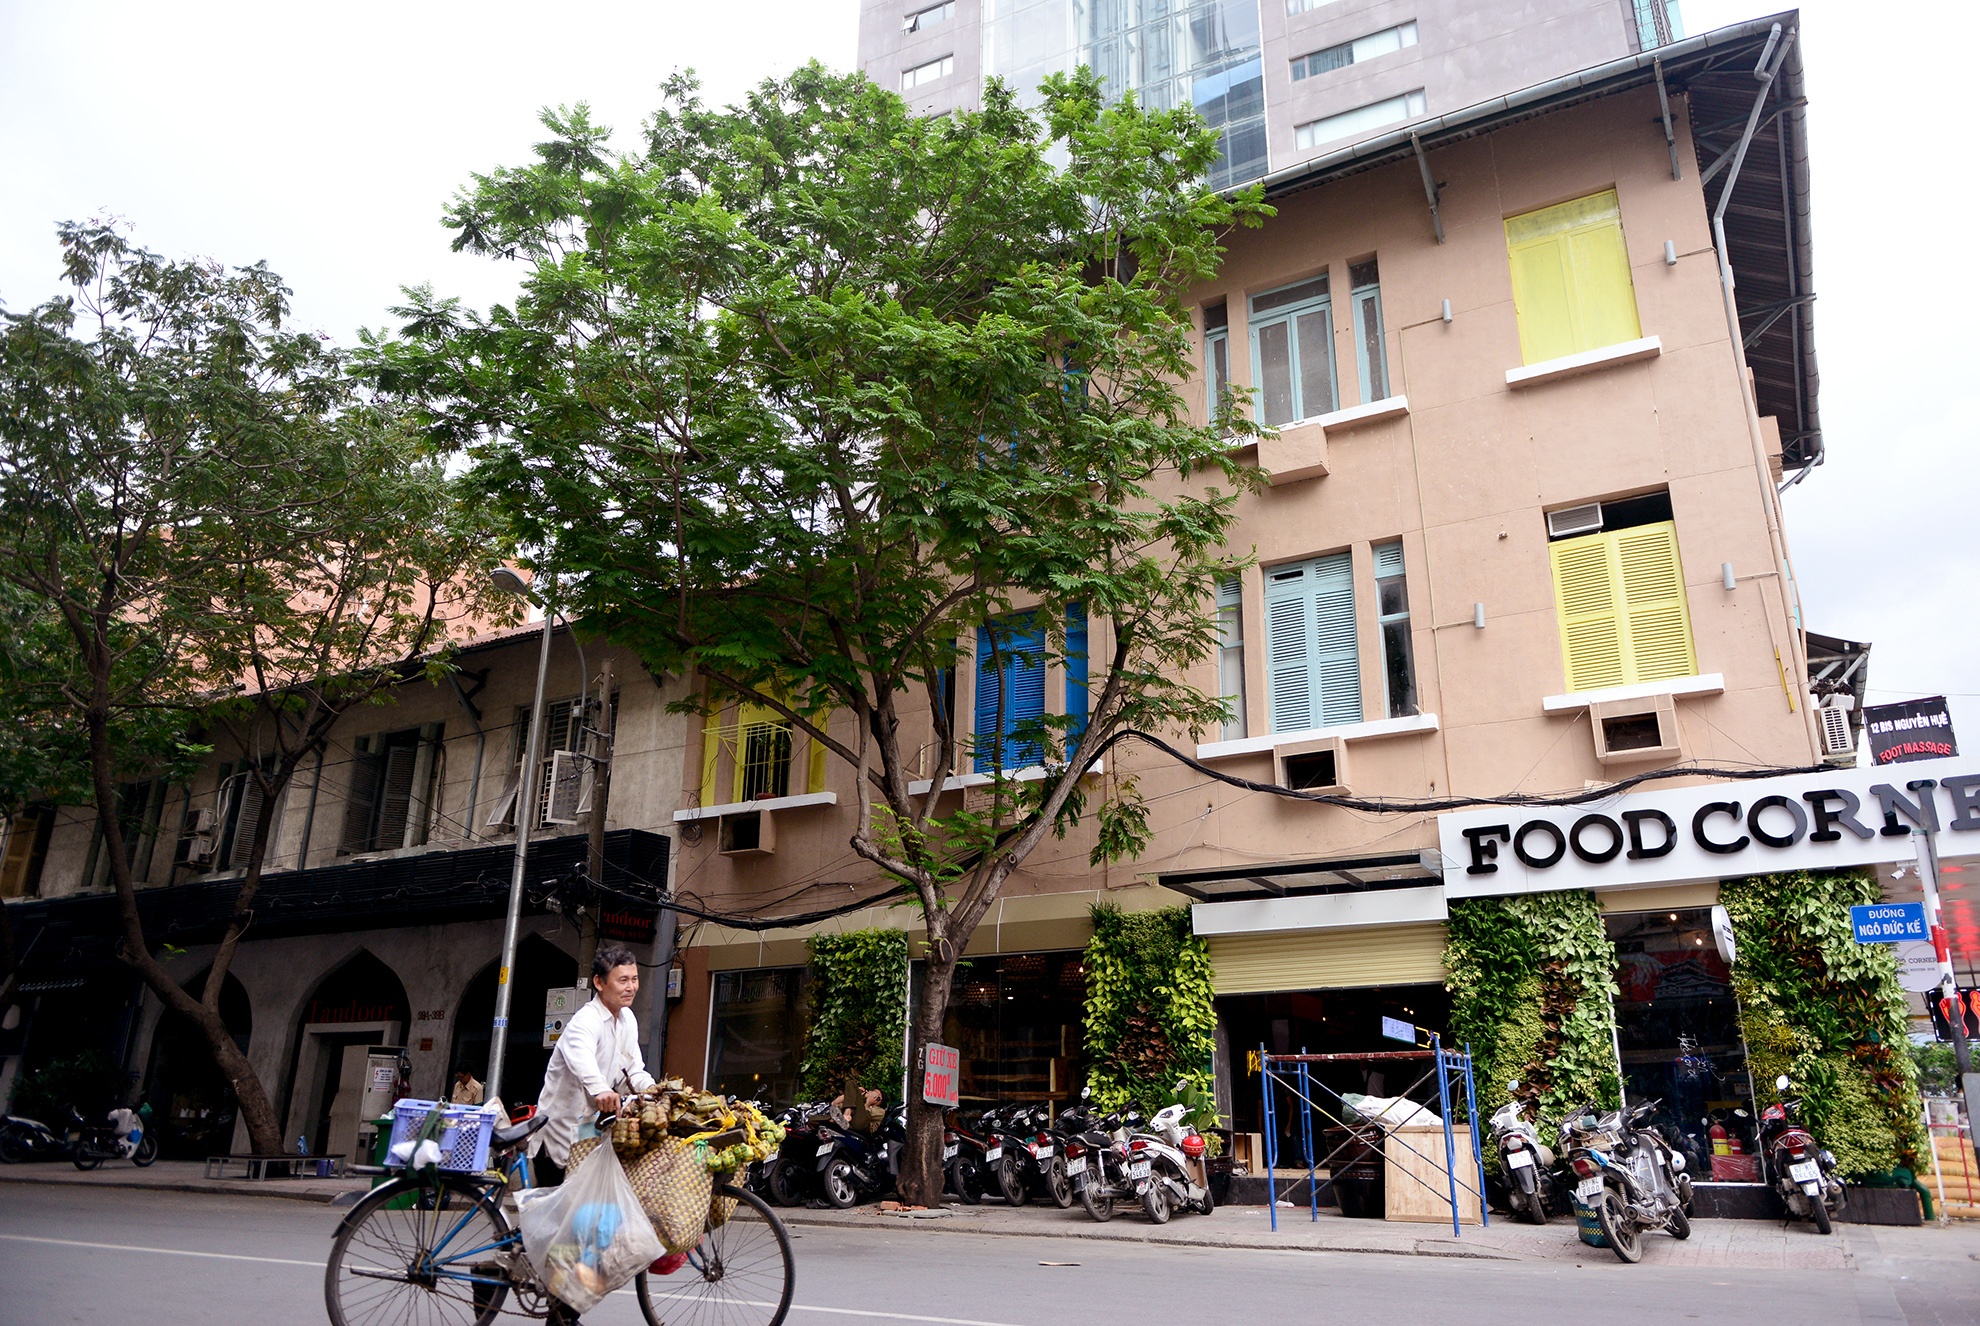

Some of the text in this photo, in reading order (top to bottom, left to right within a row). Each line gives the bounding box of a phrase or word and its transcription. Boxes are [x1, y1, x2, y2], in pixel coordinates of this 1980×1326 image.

[1870, 722, 1880, 734] 12
[1880, 720, 1894, 733] BIS
[1879, 745, 1903, 762] FOOT
[1903, 741, 1952, 756] MASSAGE
[1461, 808, 1678, 875] FOOD
[1868, 908, 1906, 919] ĐƯỜNG
[1859, 918, 1922, 937] NGÔ ĐỨC KẾ
[310, 998, 394, 1024] Tandoor
[947, 1052, 957, 1070] XE
